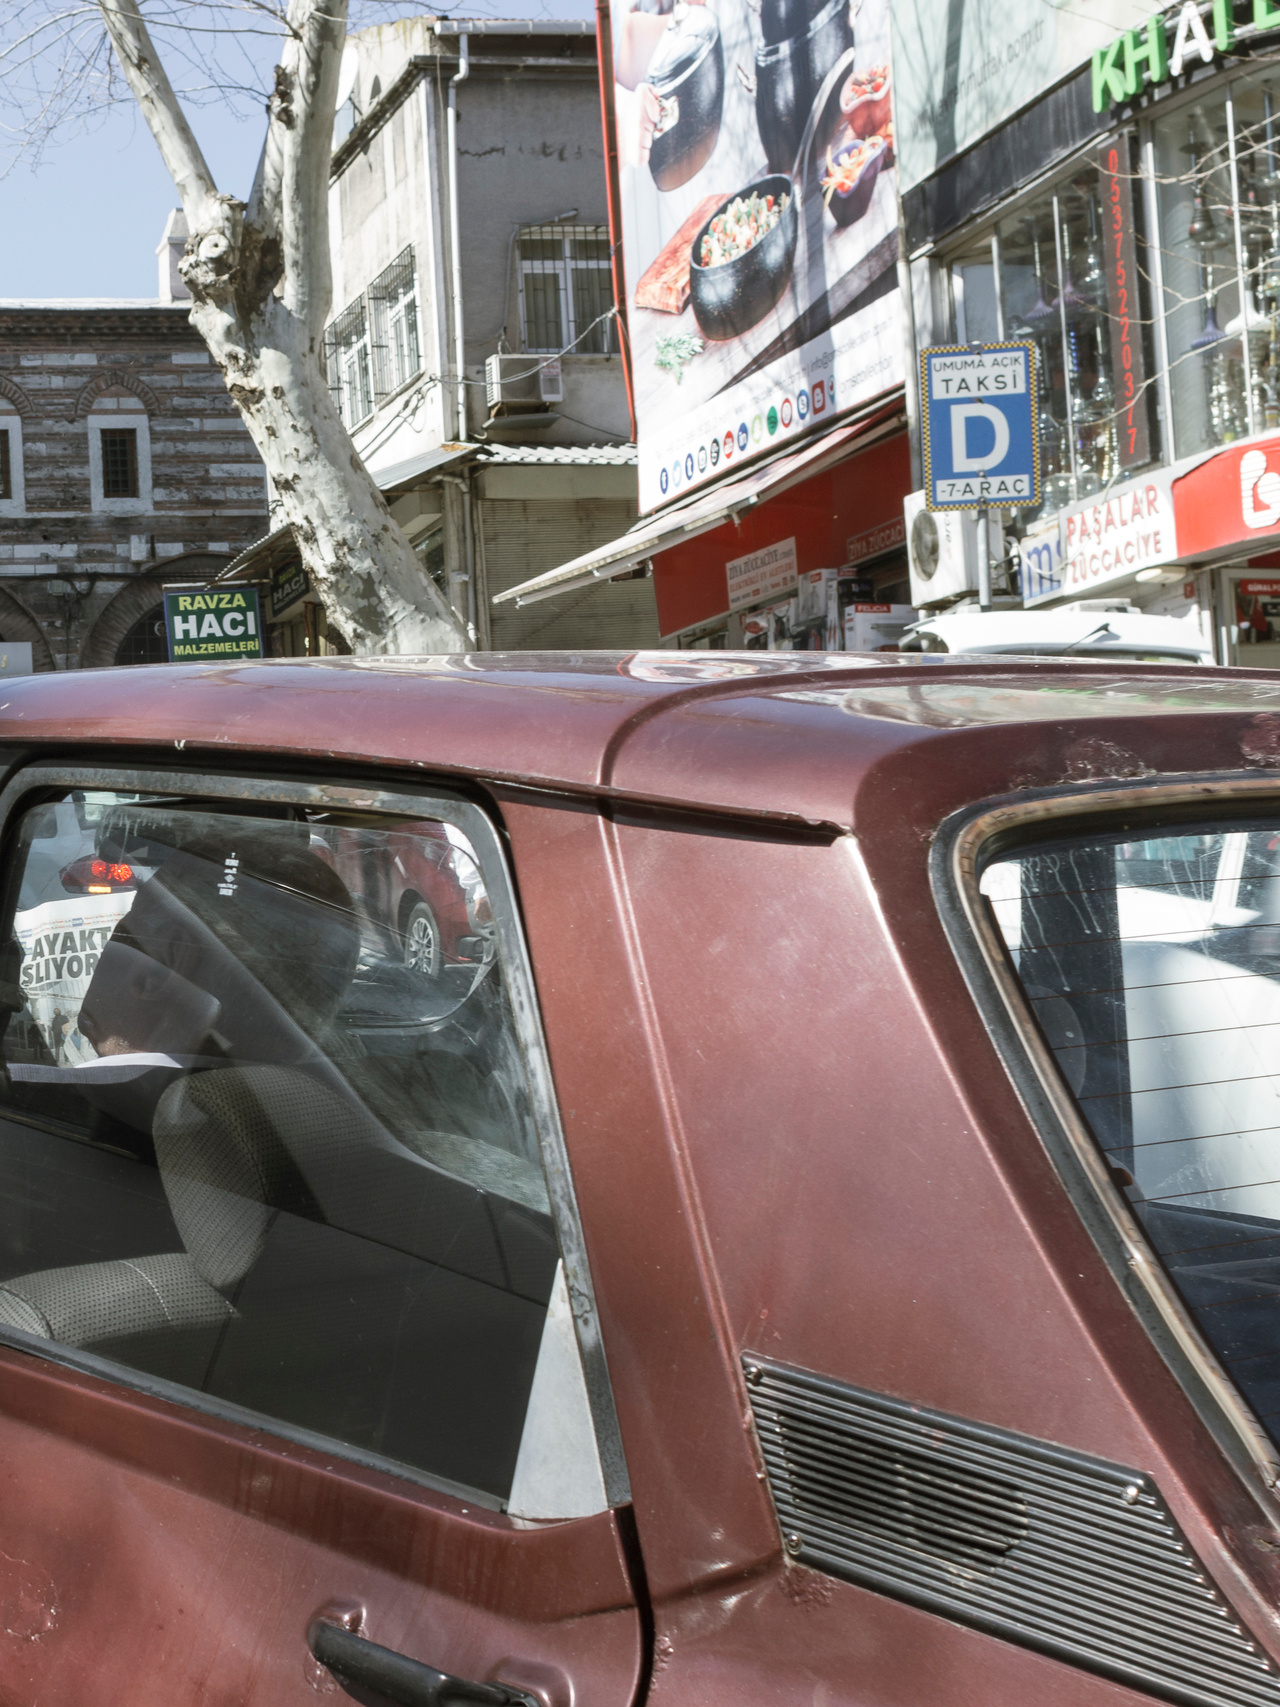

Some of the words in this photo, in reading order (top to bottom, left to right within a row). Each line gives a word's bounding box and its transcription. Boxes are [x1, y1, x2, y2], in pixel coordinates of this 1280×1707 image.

[933, 359, 985, 372] UMUMA
[991, 356, 1022, 368] AÇIK
[941, 370, 1017, 394] TAKSİ
[950, 403, 1010, 473] D
[1067, 484, 1159, 546] PAŞALAR
[1071, 531, 1162, 583] ZÜCCACİYE
[178, 593, 246, 611] RAVZA
[173, 611, 256, 640] HACI
[174, 638, 259, 656] MALZEMELERİ
